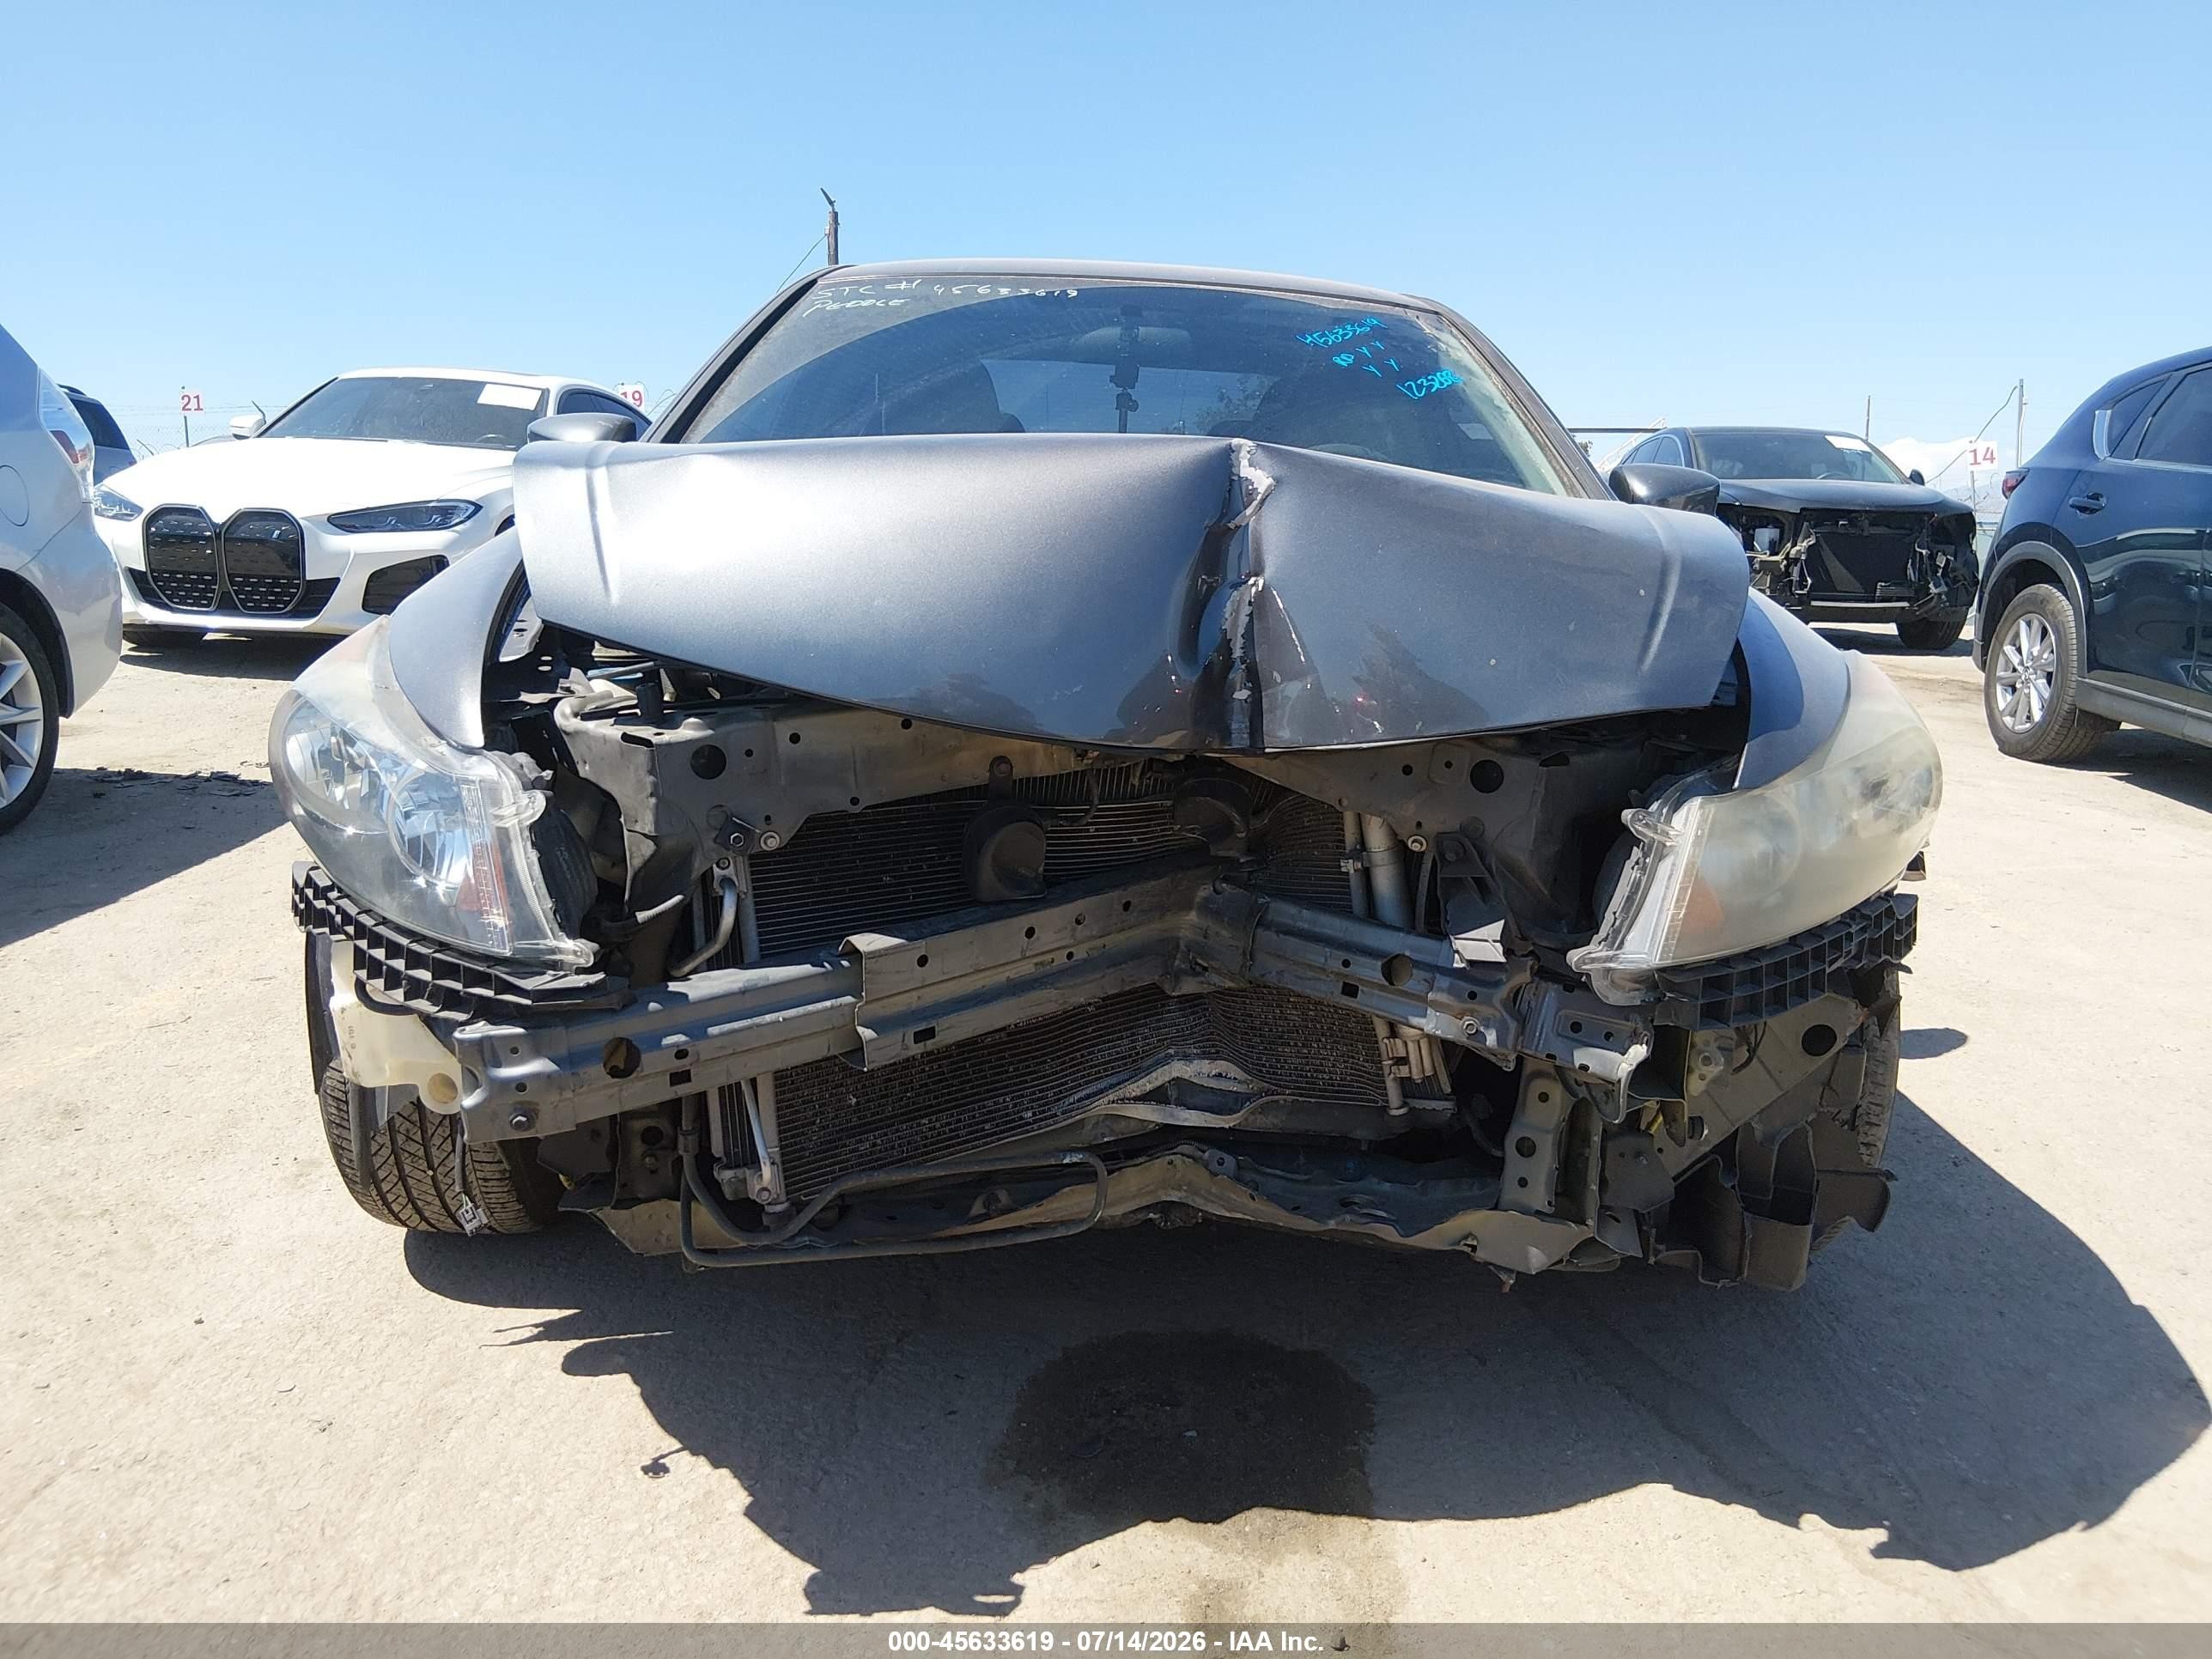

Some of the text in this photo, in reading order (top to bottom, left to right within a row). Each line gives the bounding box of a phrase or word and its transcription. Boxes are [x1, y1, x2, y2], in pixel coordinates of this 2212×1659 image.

[933, 284, 1079, 298] 45633619
[1295, 318, 1389, 349] 45633619
[180, 394, 204, 411] 21
[1968, 447, 1996, 465] 14
